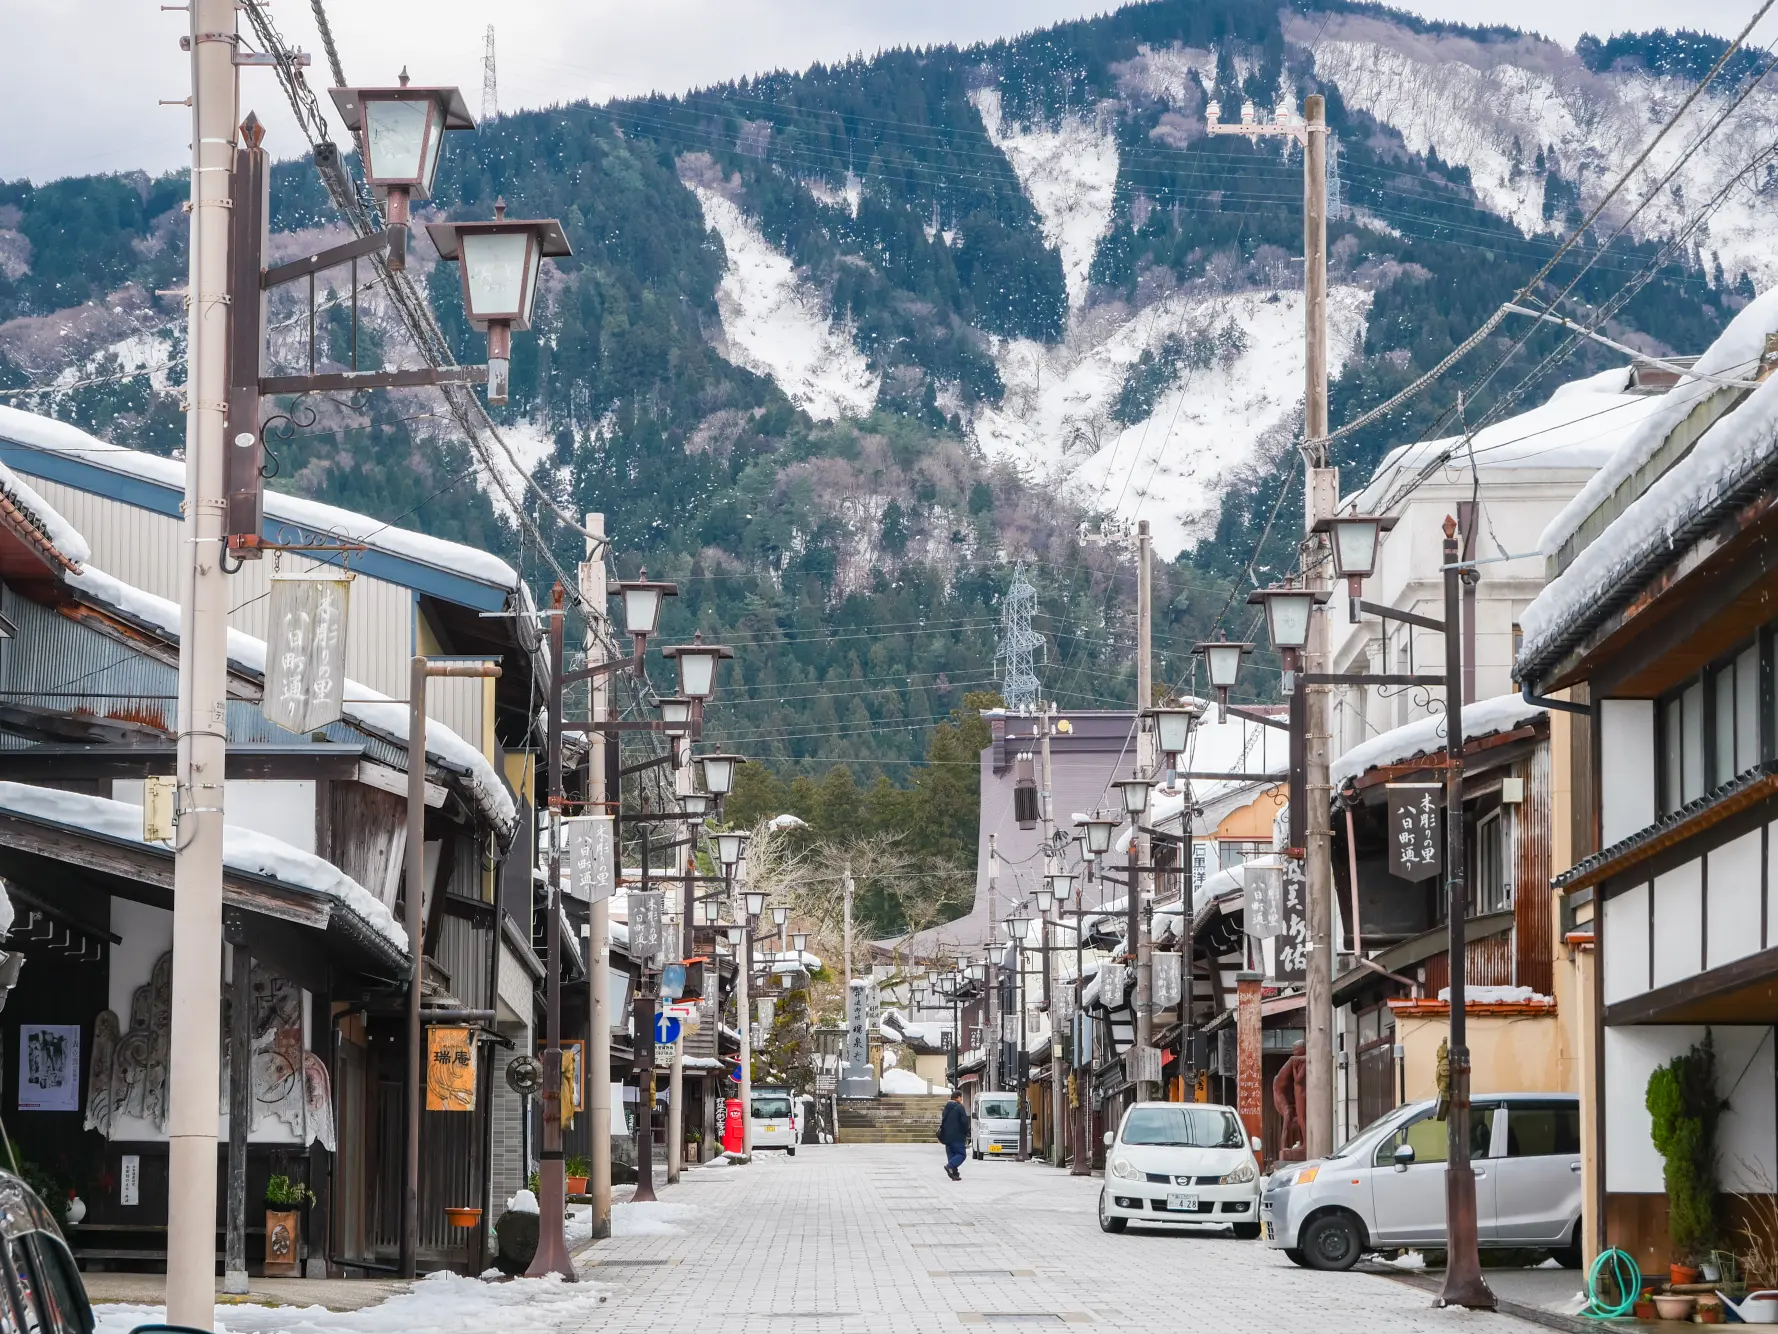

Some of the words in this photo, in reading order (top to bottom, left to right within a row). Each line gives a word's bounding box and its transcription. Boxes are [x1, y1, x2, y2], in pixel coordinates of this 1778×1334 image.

[280, 611, 309, 717] 八日町通り
[313, 588, 340, 703] 木彫りの里
[596, 824, 609, 887] 木彫りの里
[1397, 805, 1420, 872] 八日町通り
[1420, 792, 1436, 864] 木彫りの里
[575, 836, 597, 893] 八日町通り
[633, 907, 648, 951] 八日町通り
[646, 897, 658, 945] 木彫りの里
[1251, 882, 1267, 932] 八日町通り
[433, 1050, 471, 1066] 瑞庵
